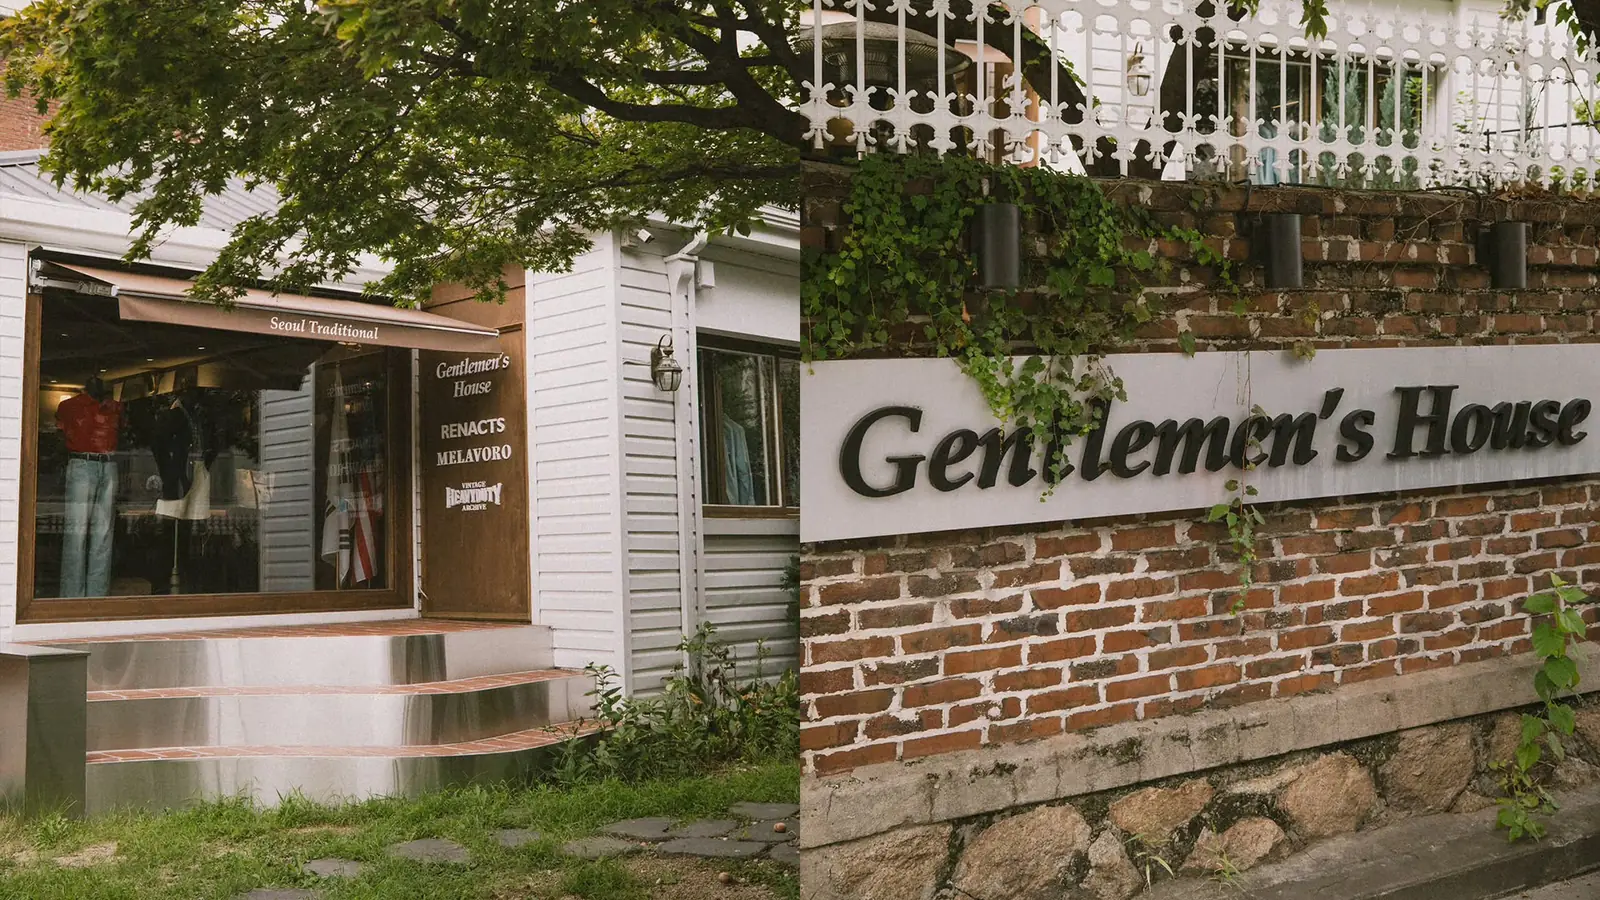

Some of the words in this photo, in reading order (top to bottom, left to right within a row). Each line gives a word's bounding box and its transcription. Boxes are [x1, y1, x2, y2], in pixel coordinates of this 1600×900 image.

[270, 316, 306, 333] Seoul
[308, 319, 379, 340] Traditional
[436, 352, 510, 379] Gentlemen's
[453, 379, 492, 398] House
[441, 417, 505, 440] RENACTS
[838, 387, 1376, 498] Gentlemen's
[1386, 384, 1592, 461] House
[436, 444, 512, 466] MELAVORO
[461, 480, 487, 489] VINTAGE
[461, 503, 487, 512] ARCHIVE
